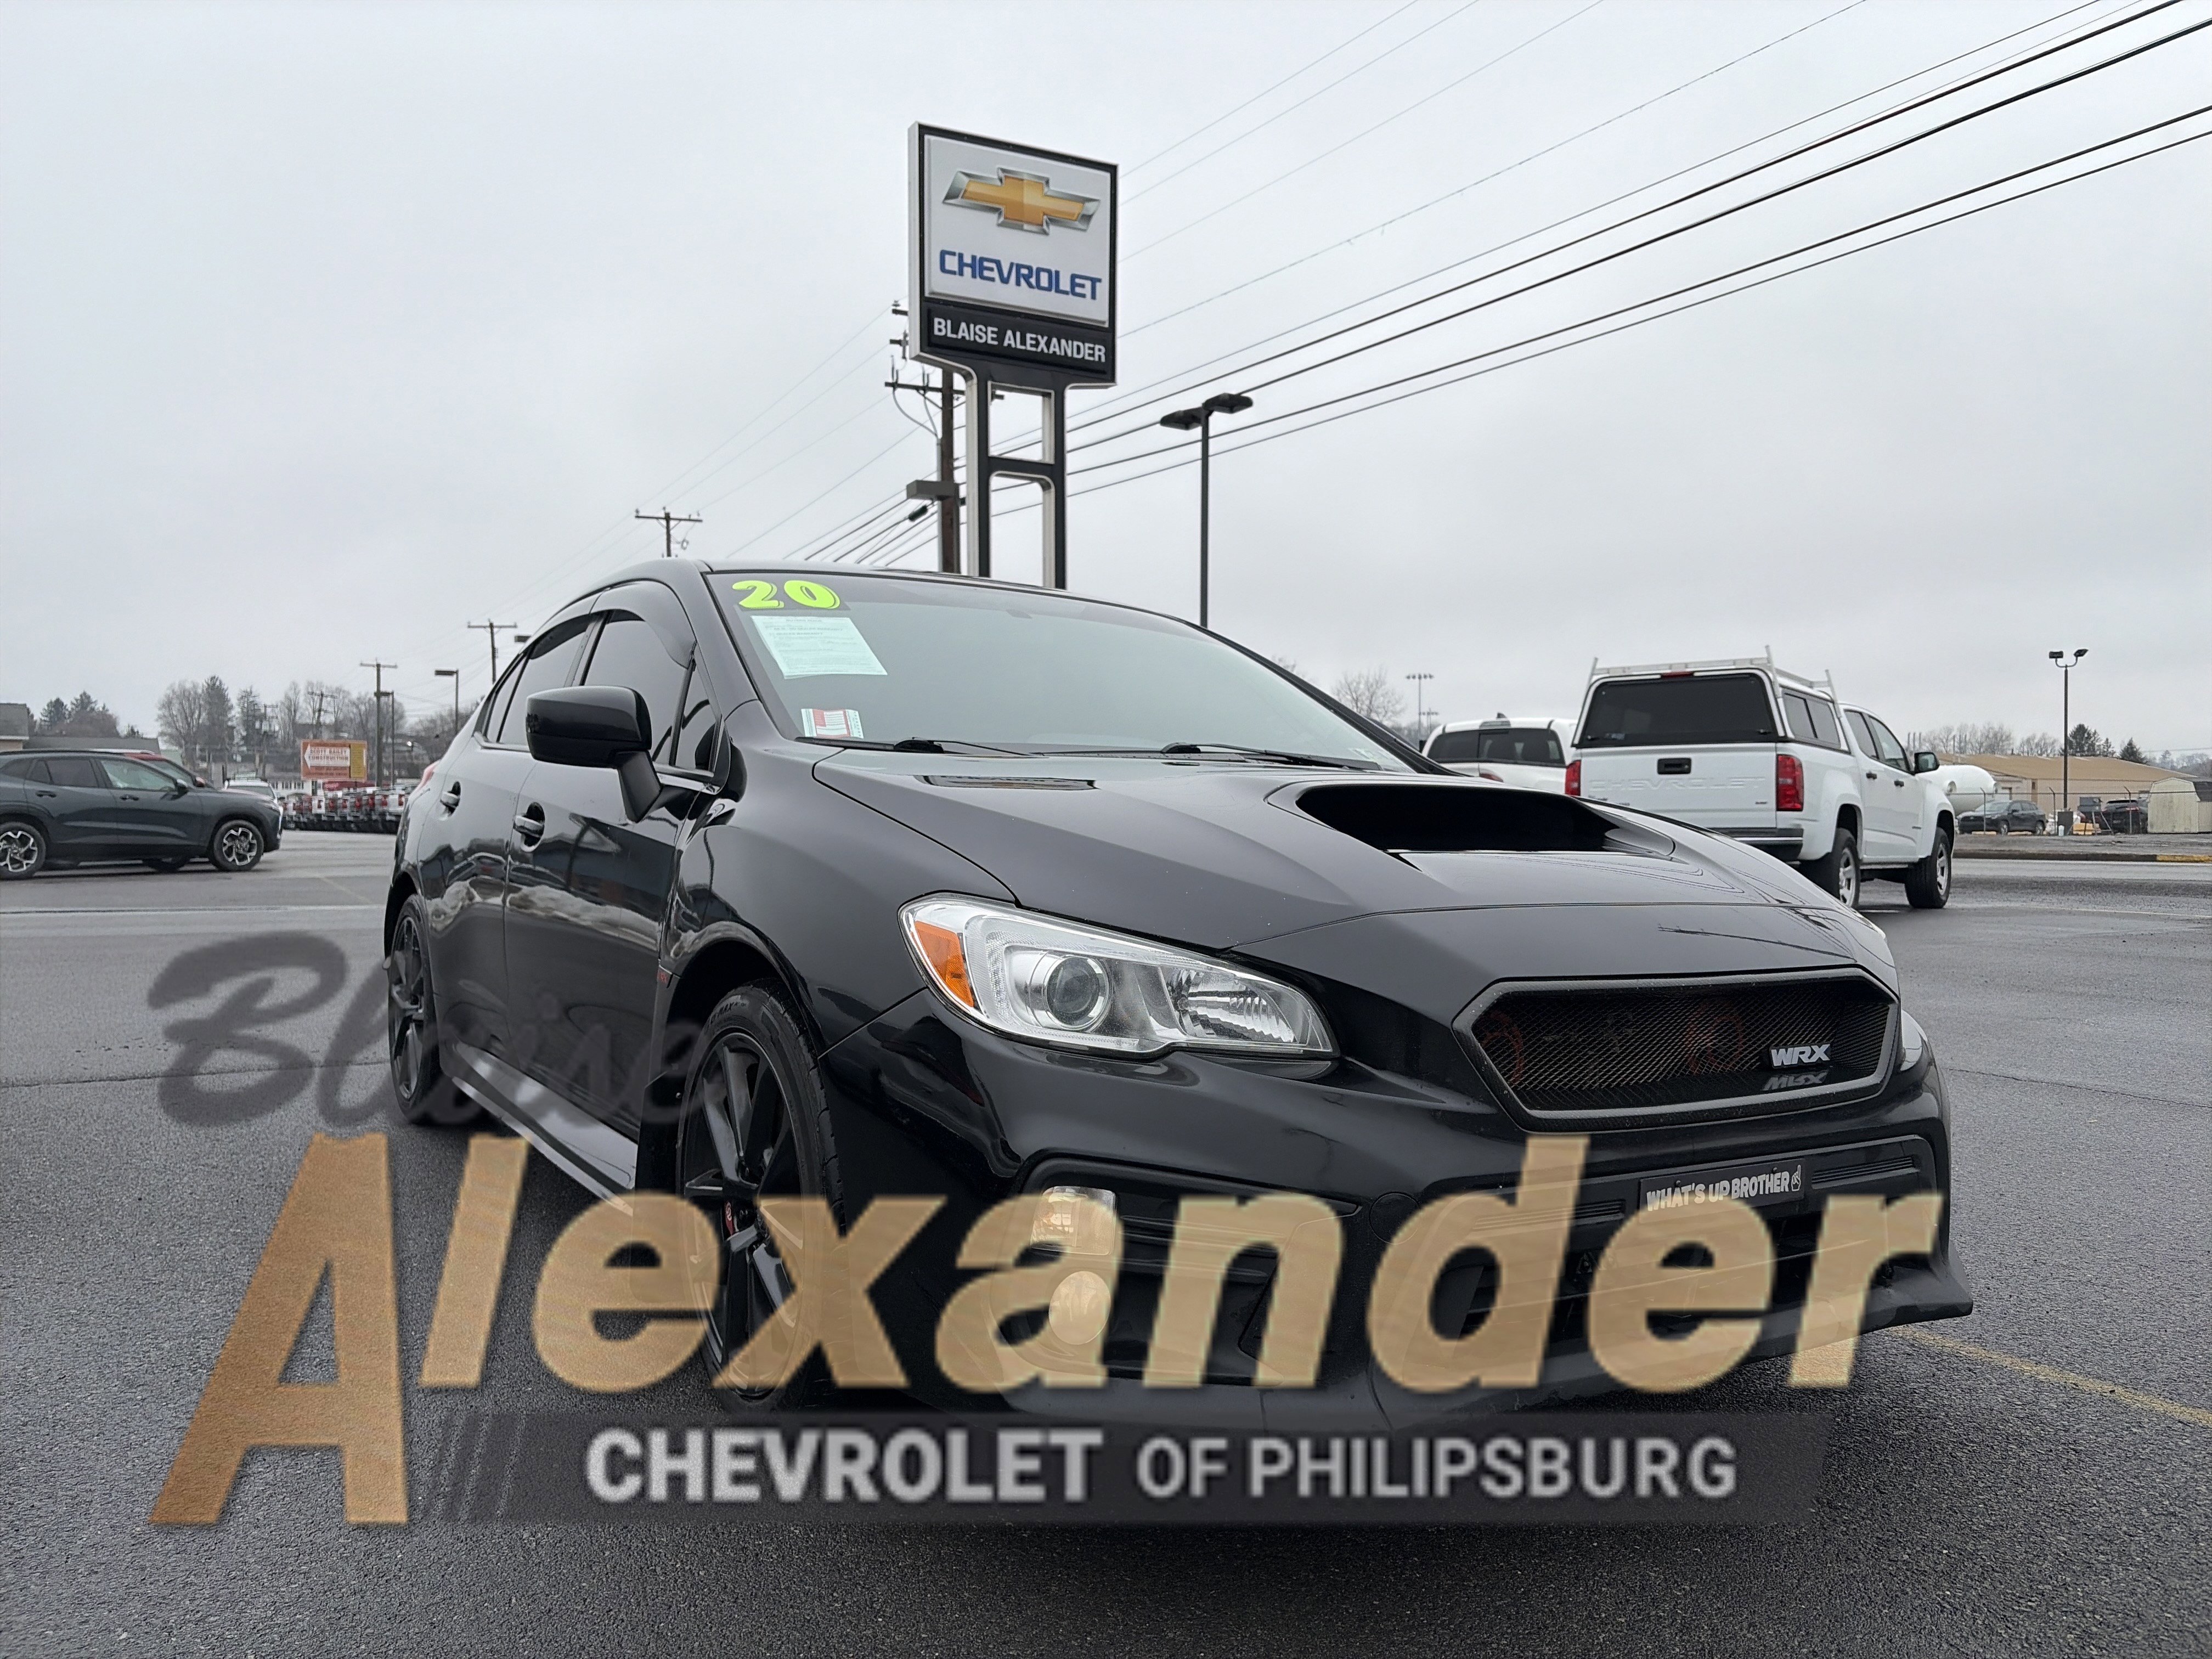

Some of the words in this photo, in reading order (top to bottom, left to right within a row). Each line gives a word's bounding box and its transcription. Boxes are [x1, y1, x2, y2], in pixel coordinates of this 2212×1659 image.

[940, 249, 1102, 300] CHEVROLET
[933, 318, 998, 345] BLAISE
[1003, 329, 1105, 363] ALEXANDER
[731, 579, 840, 610] 20
[1771, 1044, 1831, 1067] WRX
[1646, 1182, 1706, 1212] WHAT'S
[1708, 1182, 1730, 1203] UP
[1731, 1172, 1789, 1200] BROTHER
